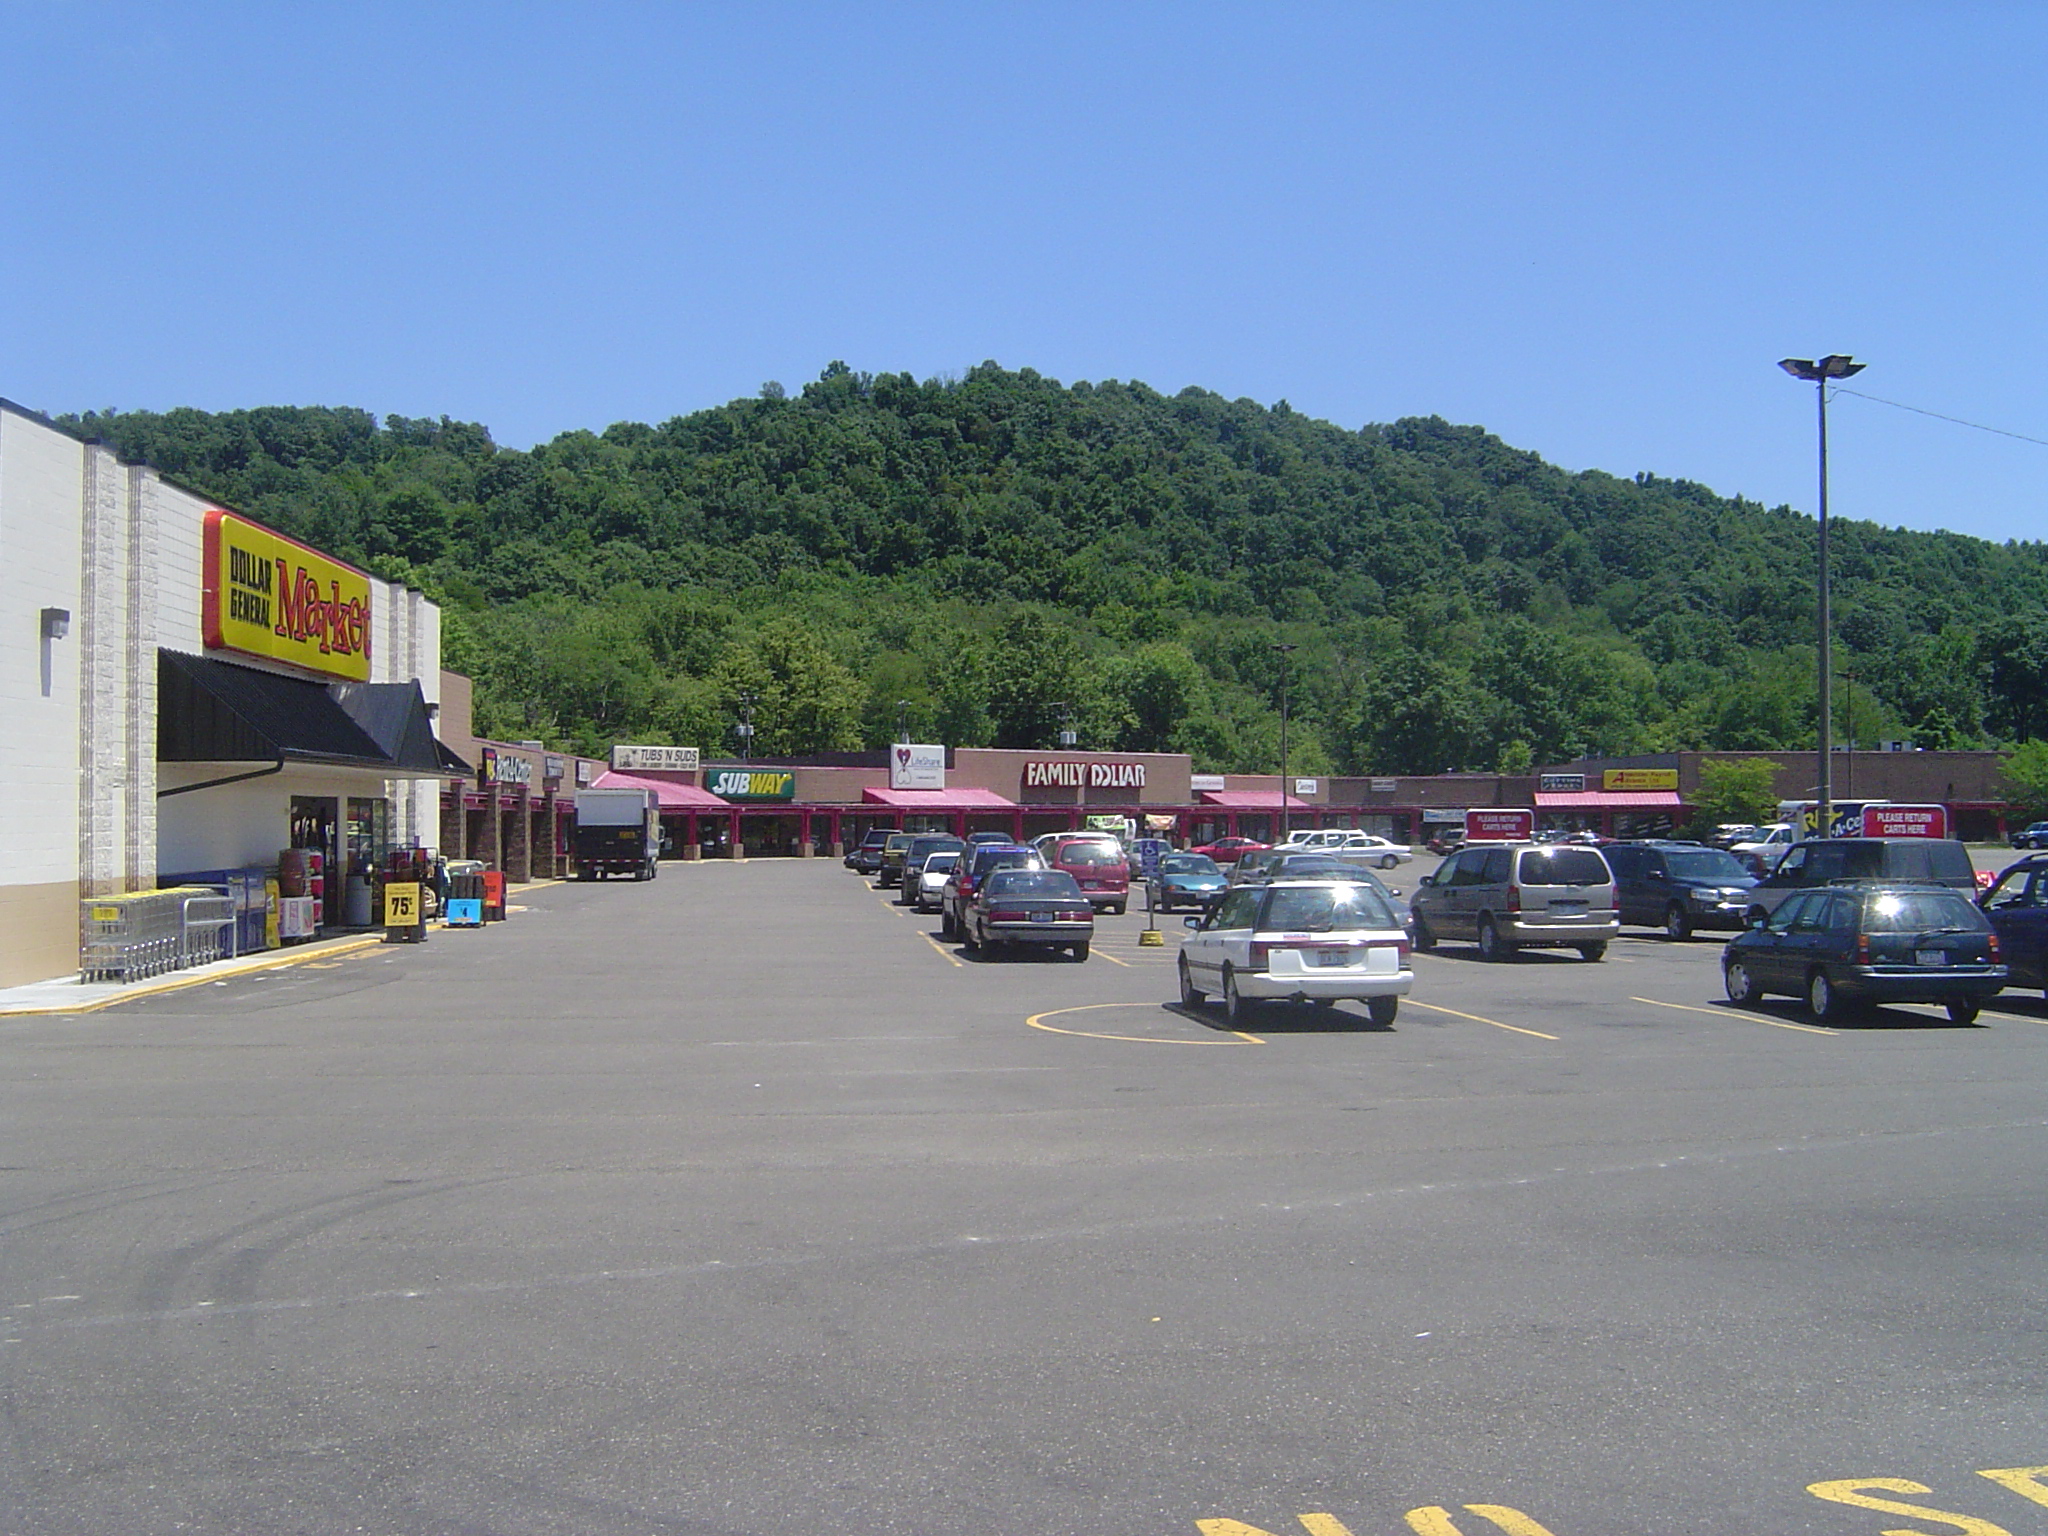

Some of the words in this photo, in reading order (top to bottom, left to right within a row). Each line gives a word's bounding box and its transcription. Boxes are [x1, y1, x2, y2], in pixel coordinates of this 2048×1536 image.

[230, 546, 271, 596] DOLLAR
[230, 588, 270, 629] GENERAL
[275, 556, 371, 660] Market
[641, 749, 662, 760] TUBS
[674, 750, 697, 762] SUDS
[712, 772, 792, 794] SUBWAY
[1027, 763, 1086, 786] FAMILY
[1091, 764, 1146, 787] DOLLAR
[1877, 812, 1904, 823] PLEASE
[1905, 813, 1932, 823] RETURN
[1883, 824, 1906, 834] CARTS
[1907, 825, 1926, 834] HERE
